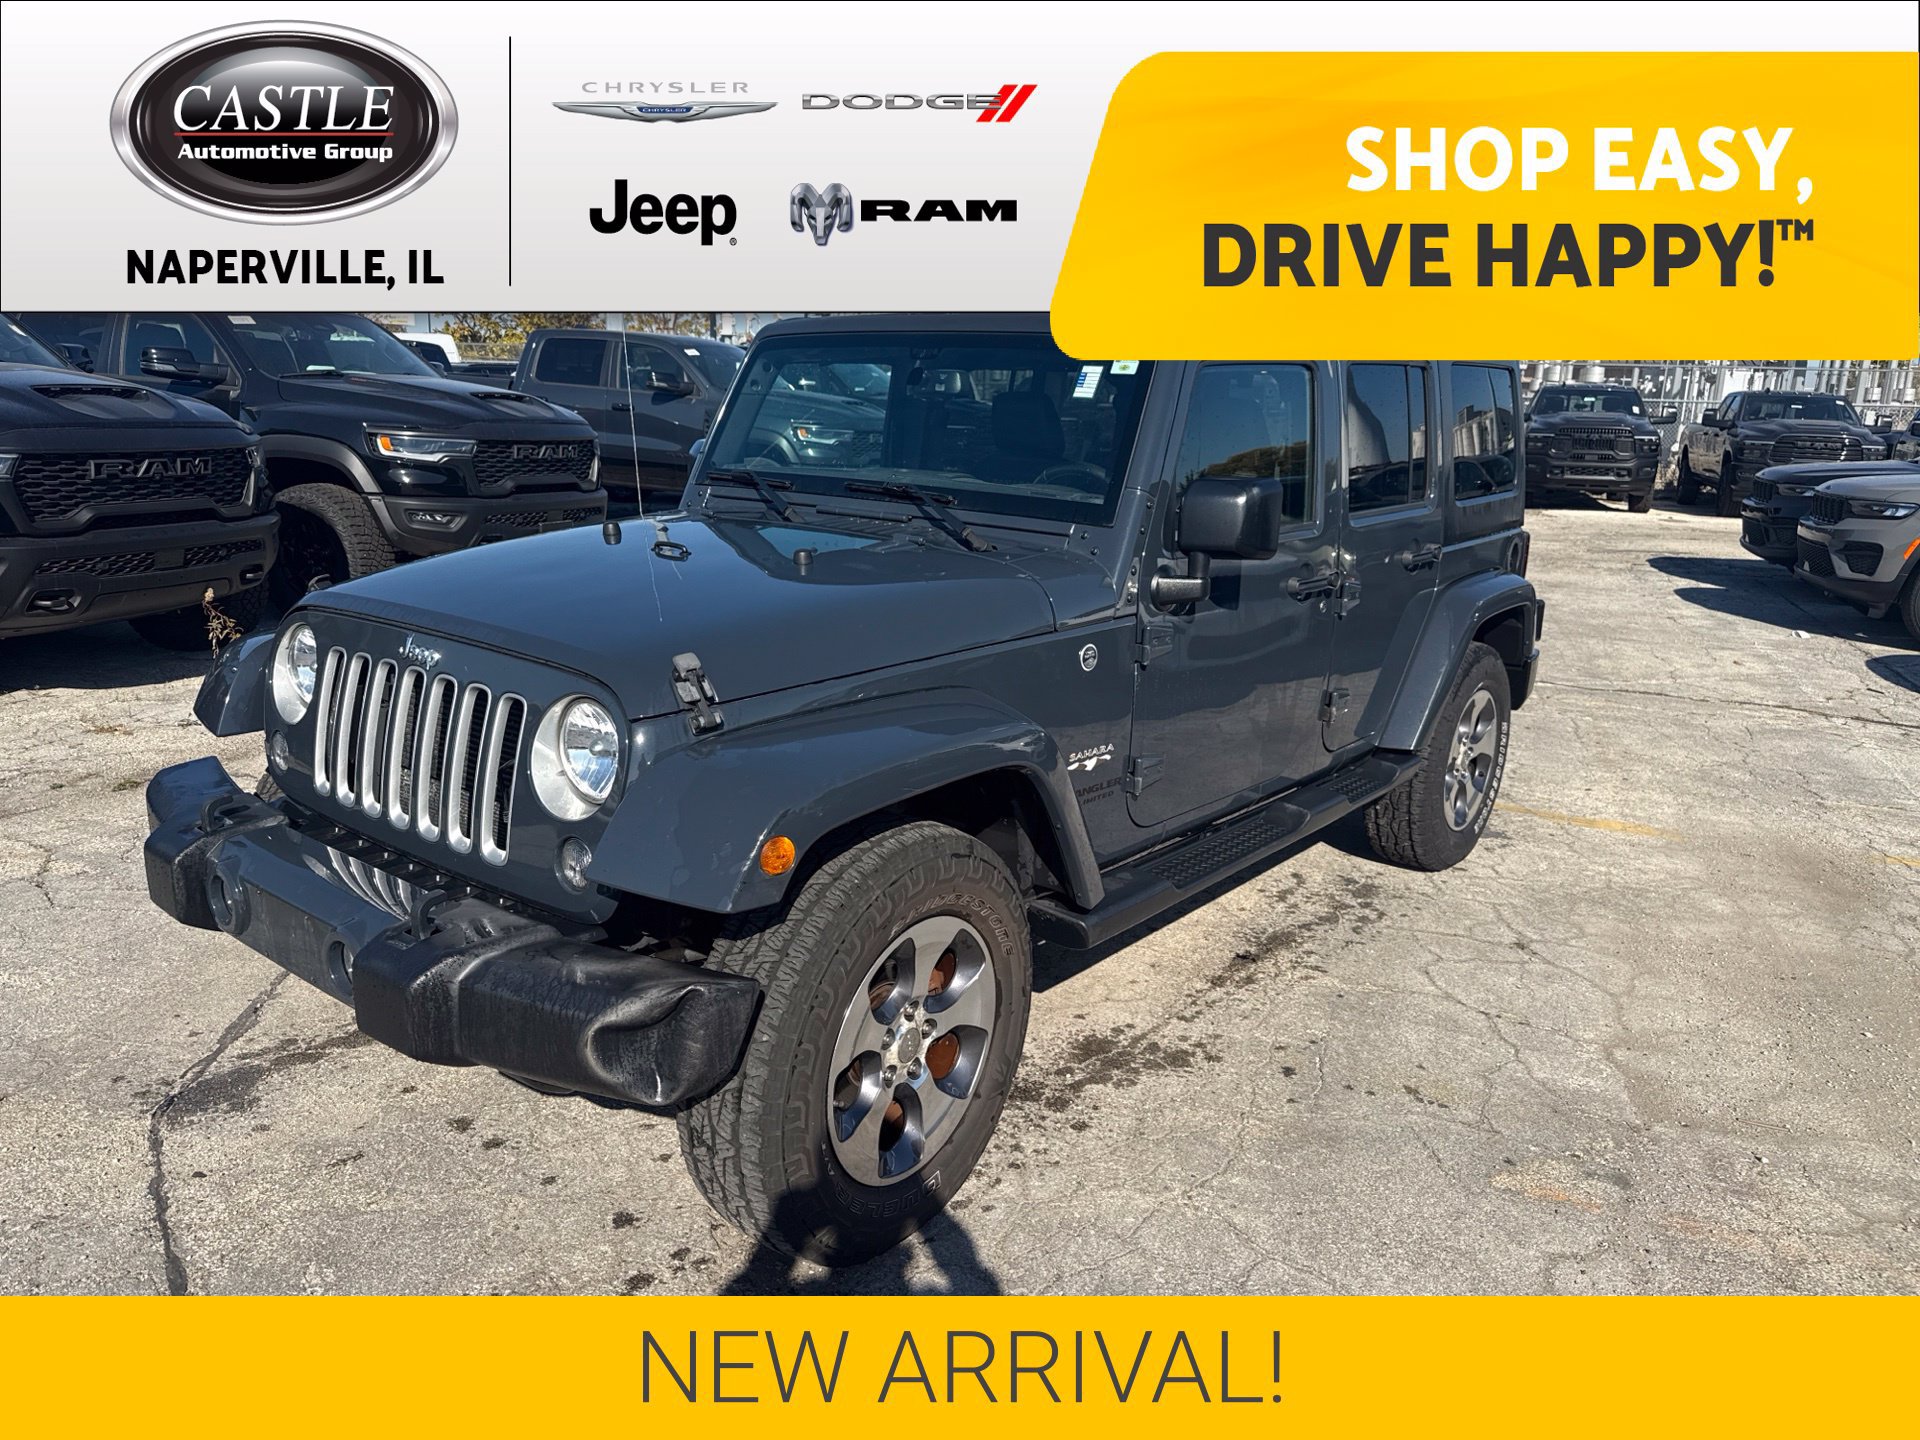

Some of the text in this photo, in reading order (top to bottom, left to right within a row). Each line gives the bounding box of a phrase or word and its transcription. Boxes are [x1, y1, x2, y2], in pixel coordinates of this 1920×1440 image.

[513, 444, 578, 459] RAM
[87, 457, 212, 480] RAM
[399, 633, 441, 670] Jeep
[1069, 743, 1114, 762] SAHARA
[1077, 777, 1122, 797] ANGLER
